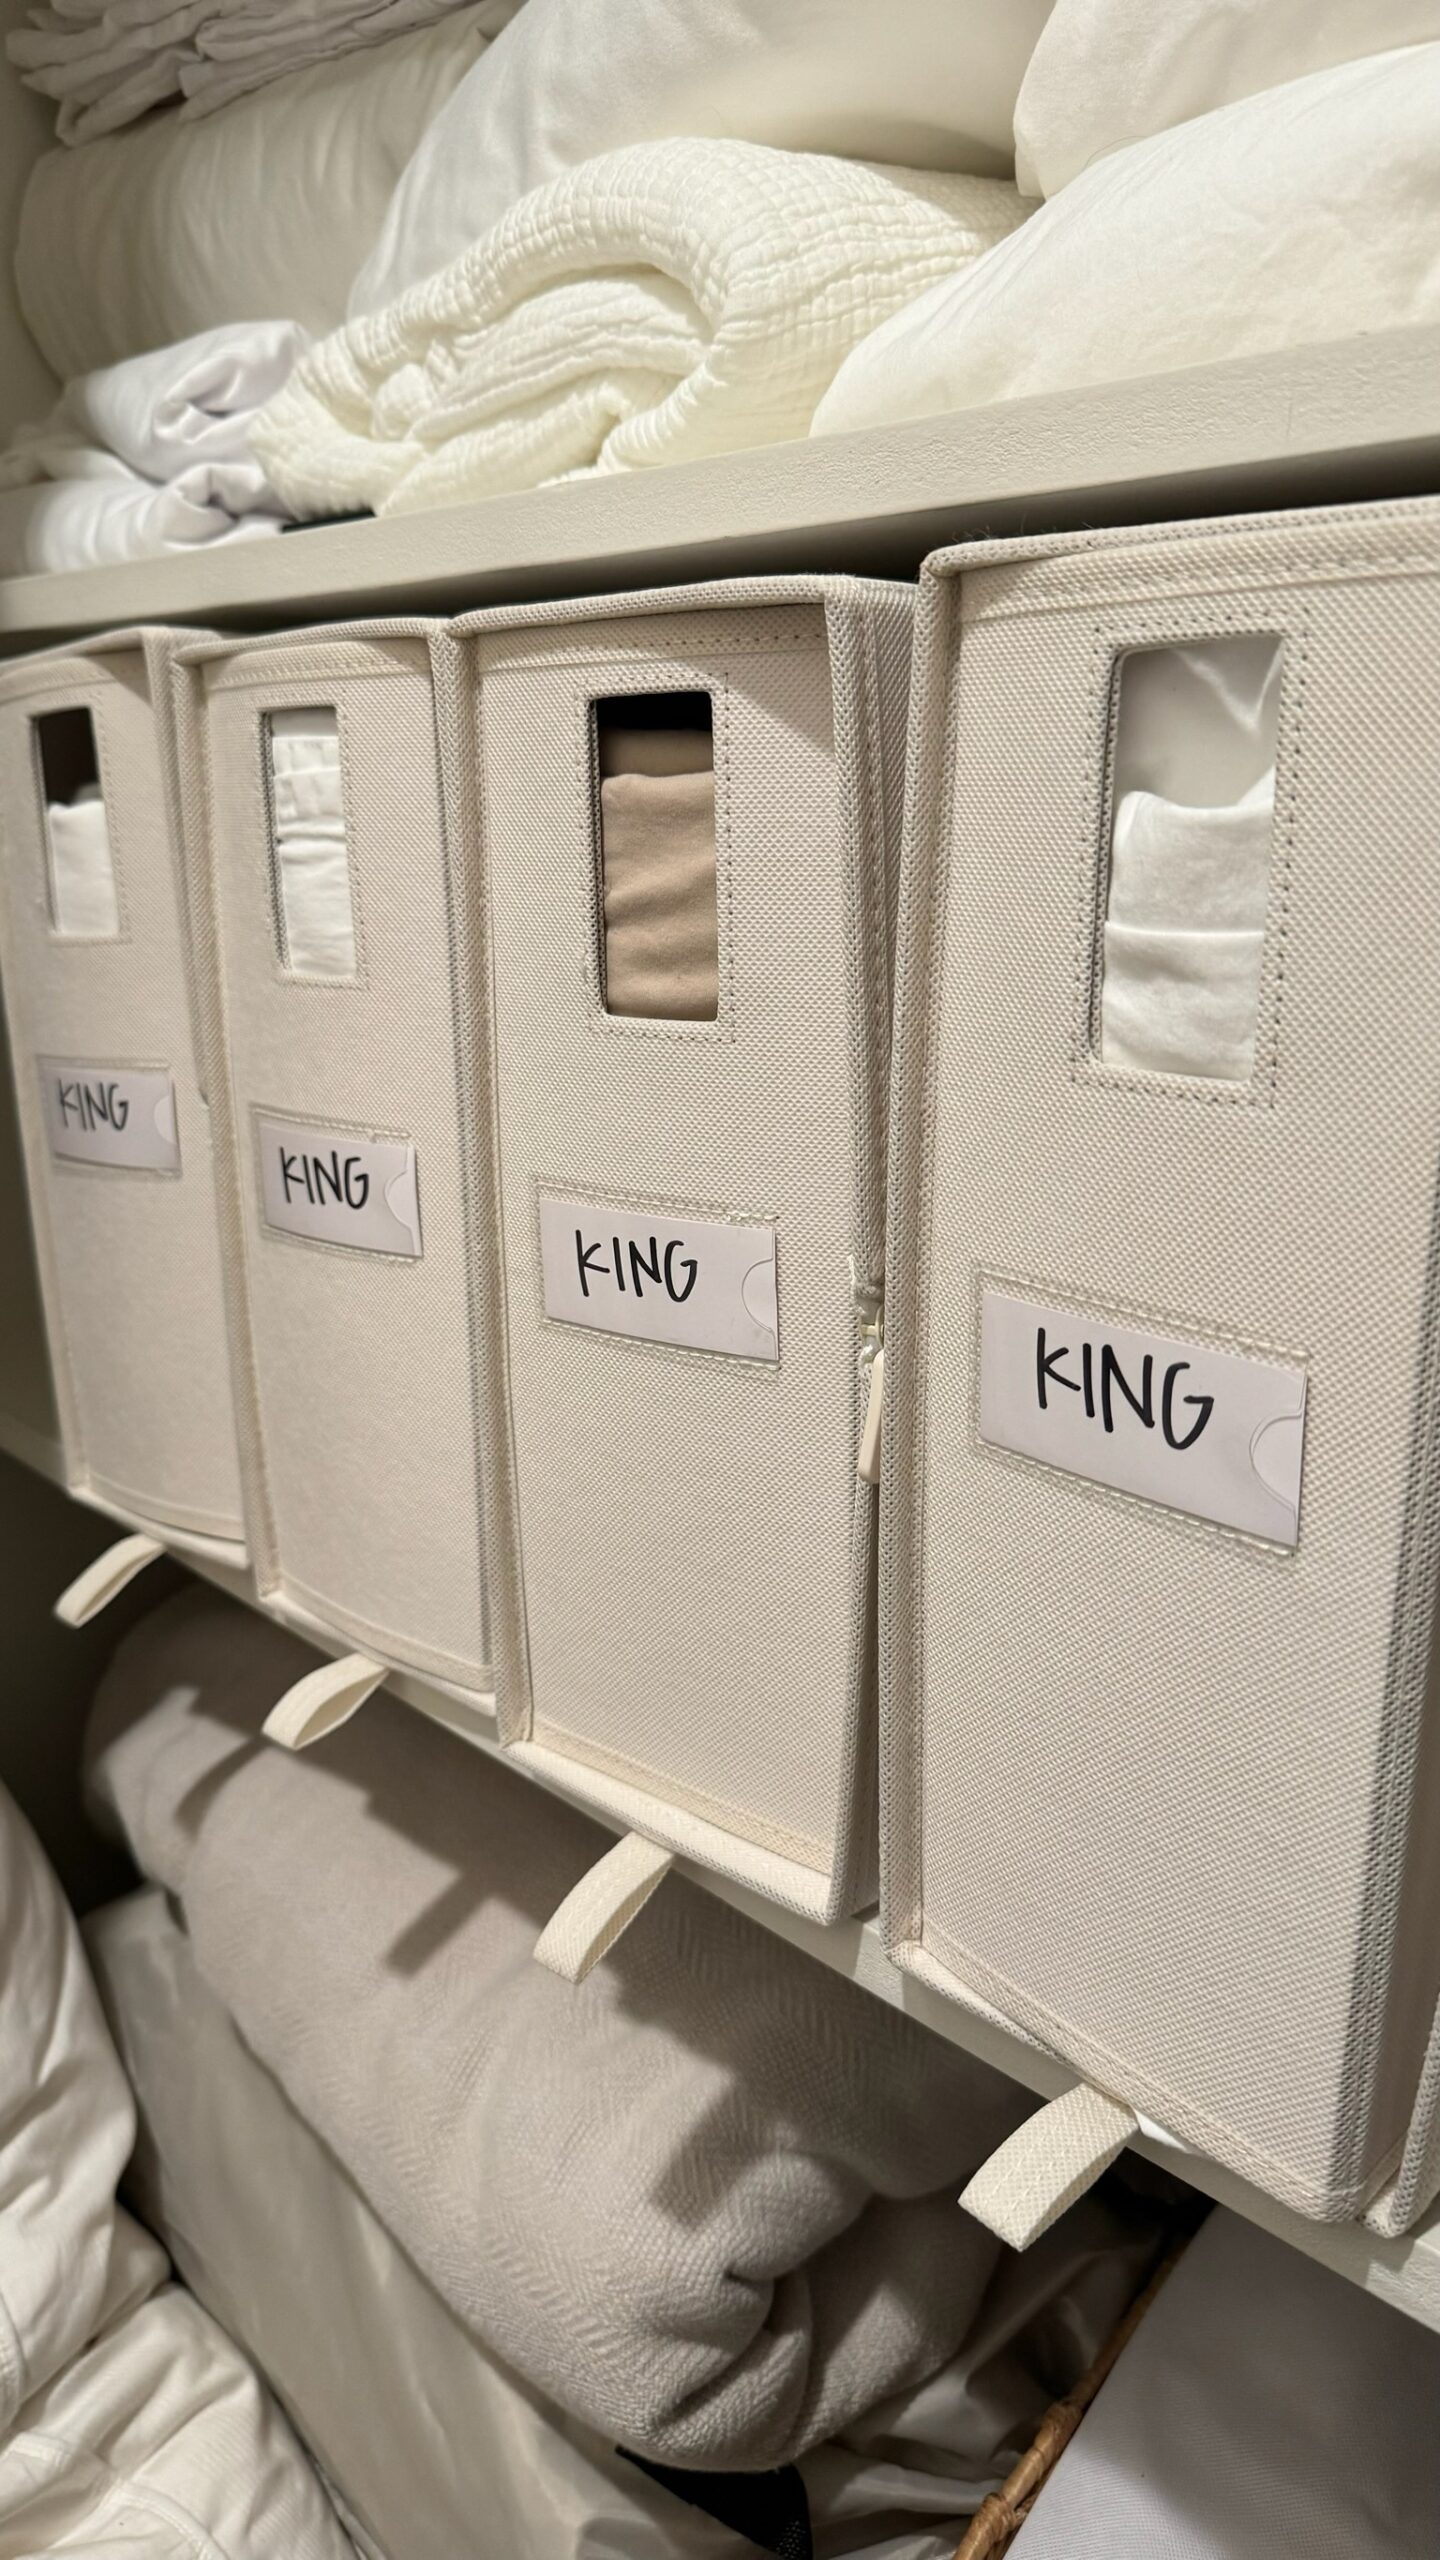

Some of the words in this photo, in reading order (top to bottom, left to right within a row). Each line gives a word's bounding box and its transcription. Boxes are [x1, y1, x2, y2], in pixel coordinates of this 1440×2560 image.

[57, 1079, 129, 1132] KING
[279, 1146, 371, 1210] KING
[575, 1229, 698, 1303] KING
[1036, 1327, 1215, 1451] KING
